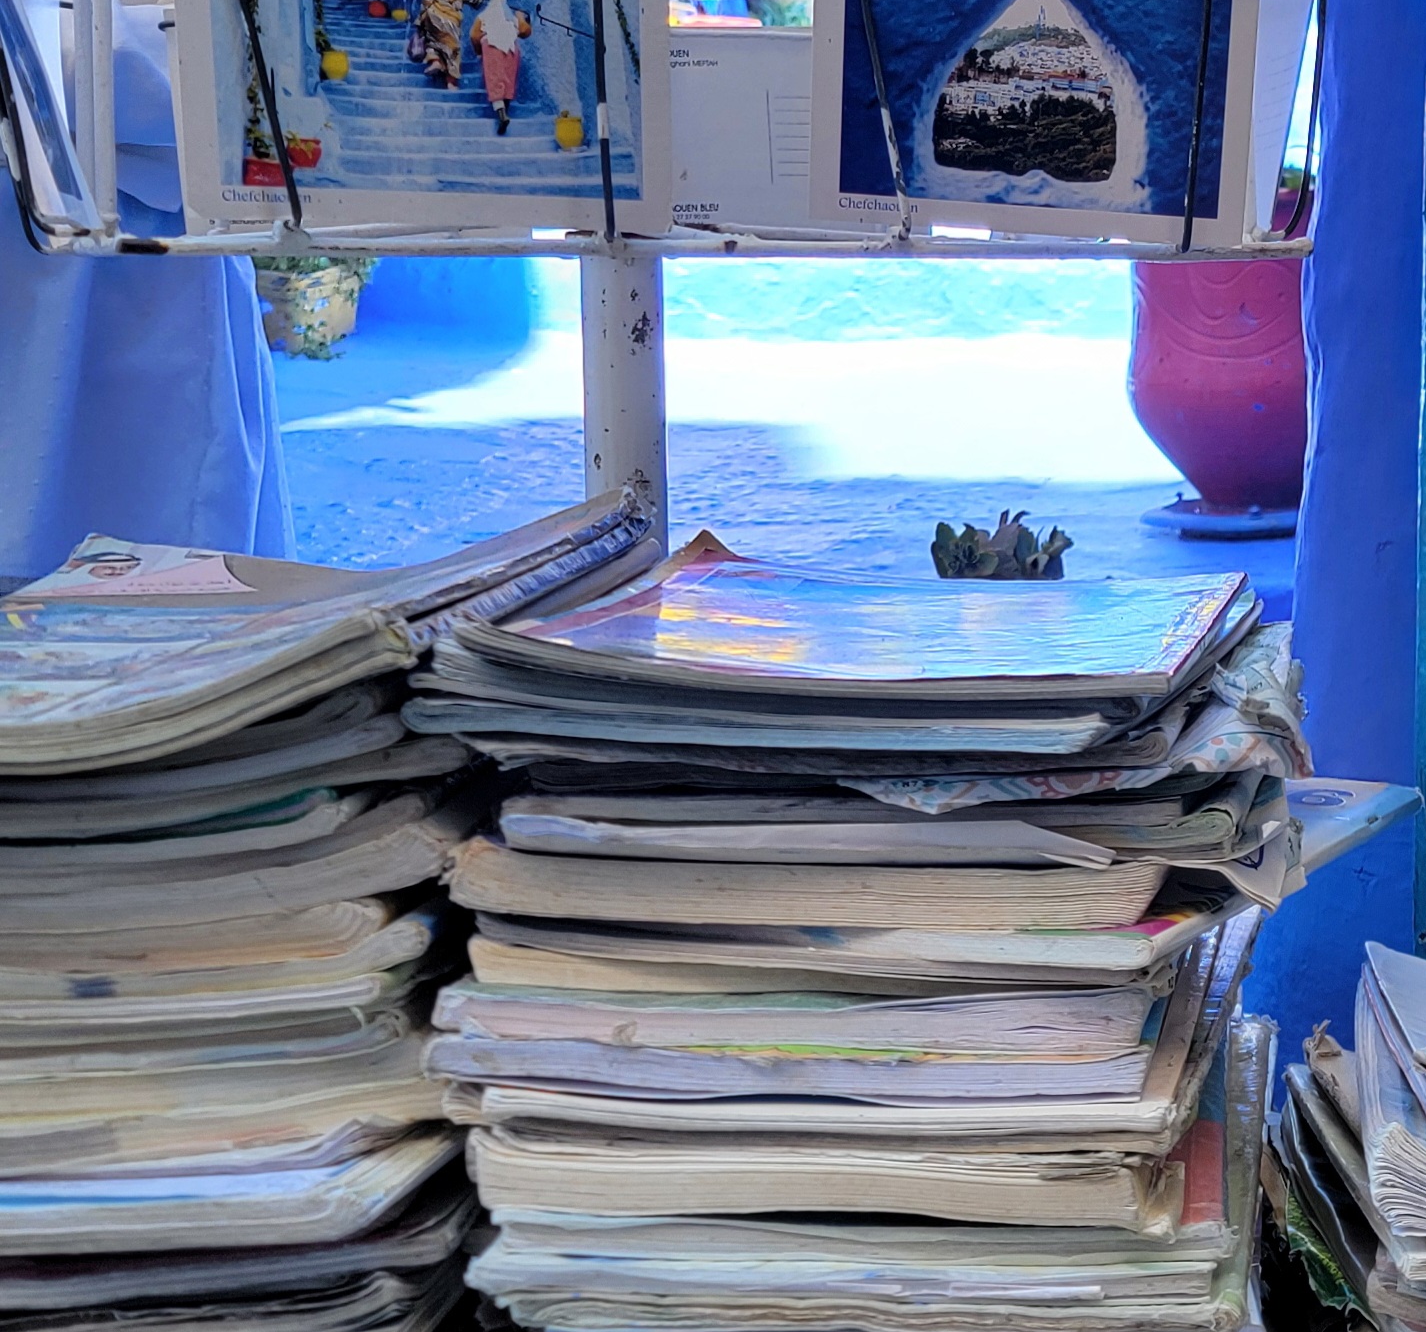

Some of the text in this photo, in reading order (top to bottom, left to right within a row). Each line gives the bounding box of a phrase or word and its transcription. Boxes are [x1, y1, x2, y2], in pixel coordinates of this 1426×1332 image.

[222, 189, 311, 204] Chefchaon
[700, 203, 720, 212] BLEU
[838, 196, 918, 214] Chefchaon
